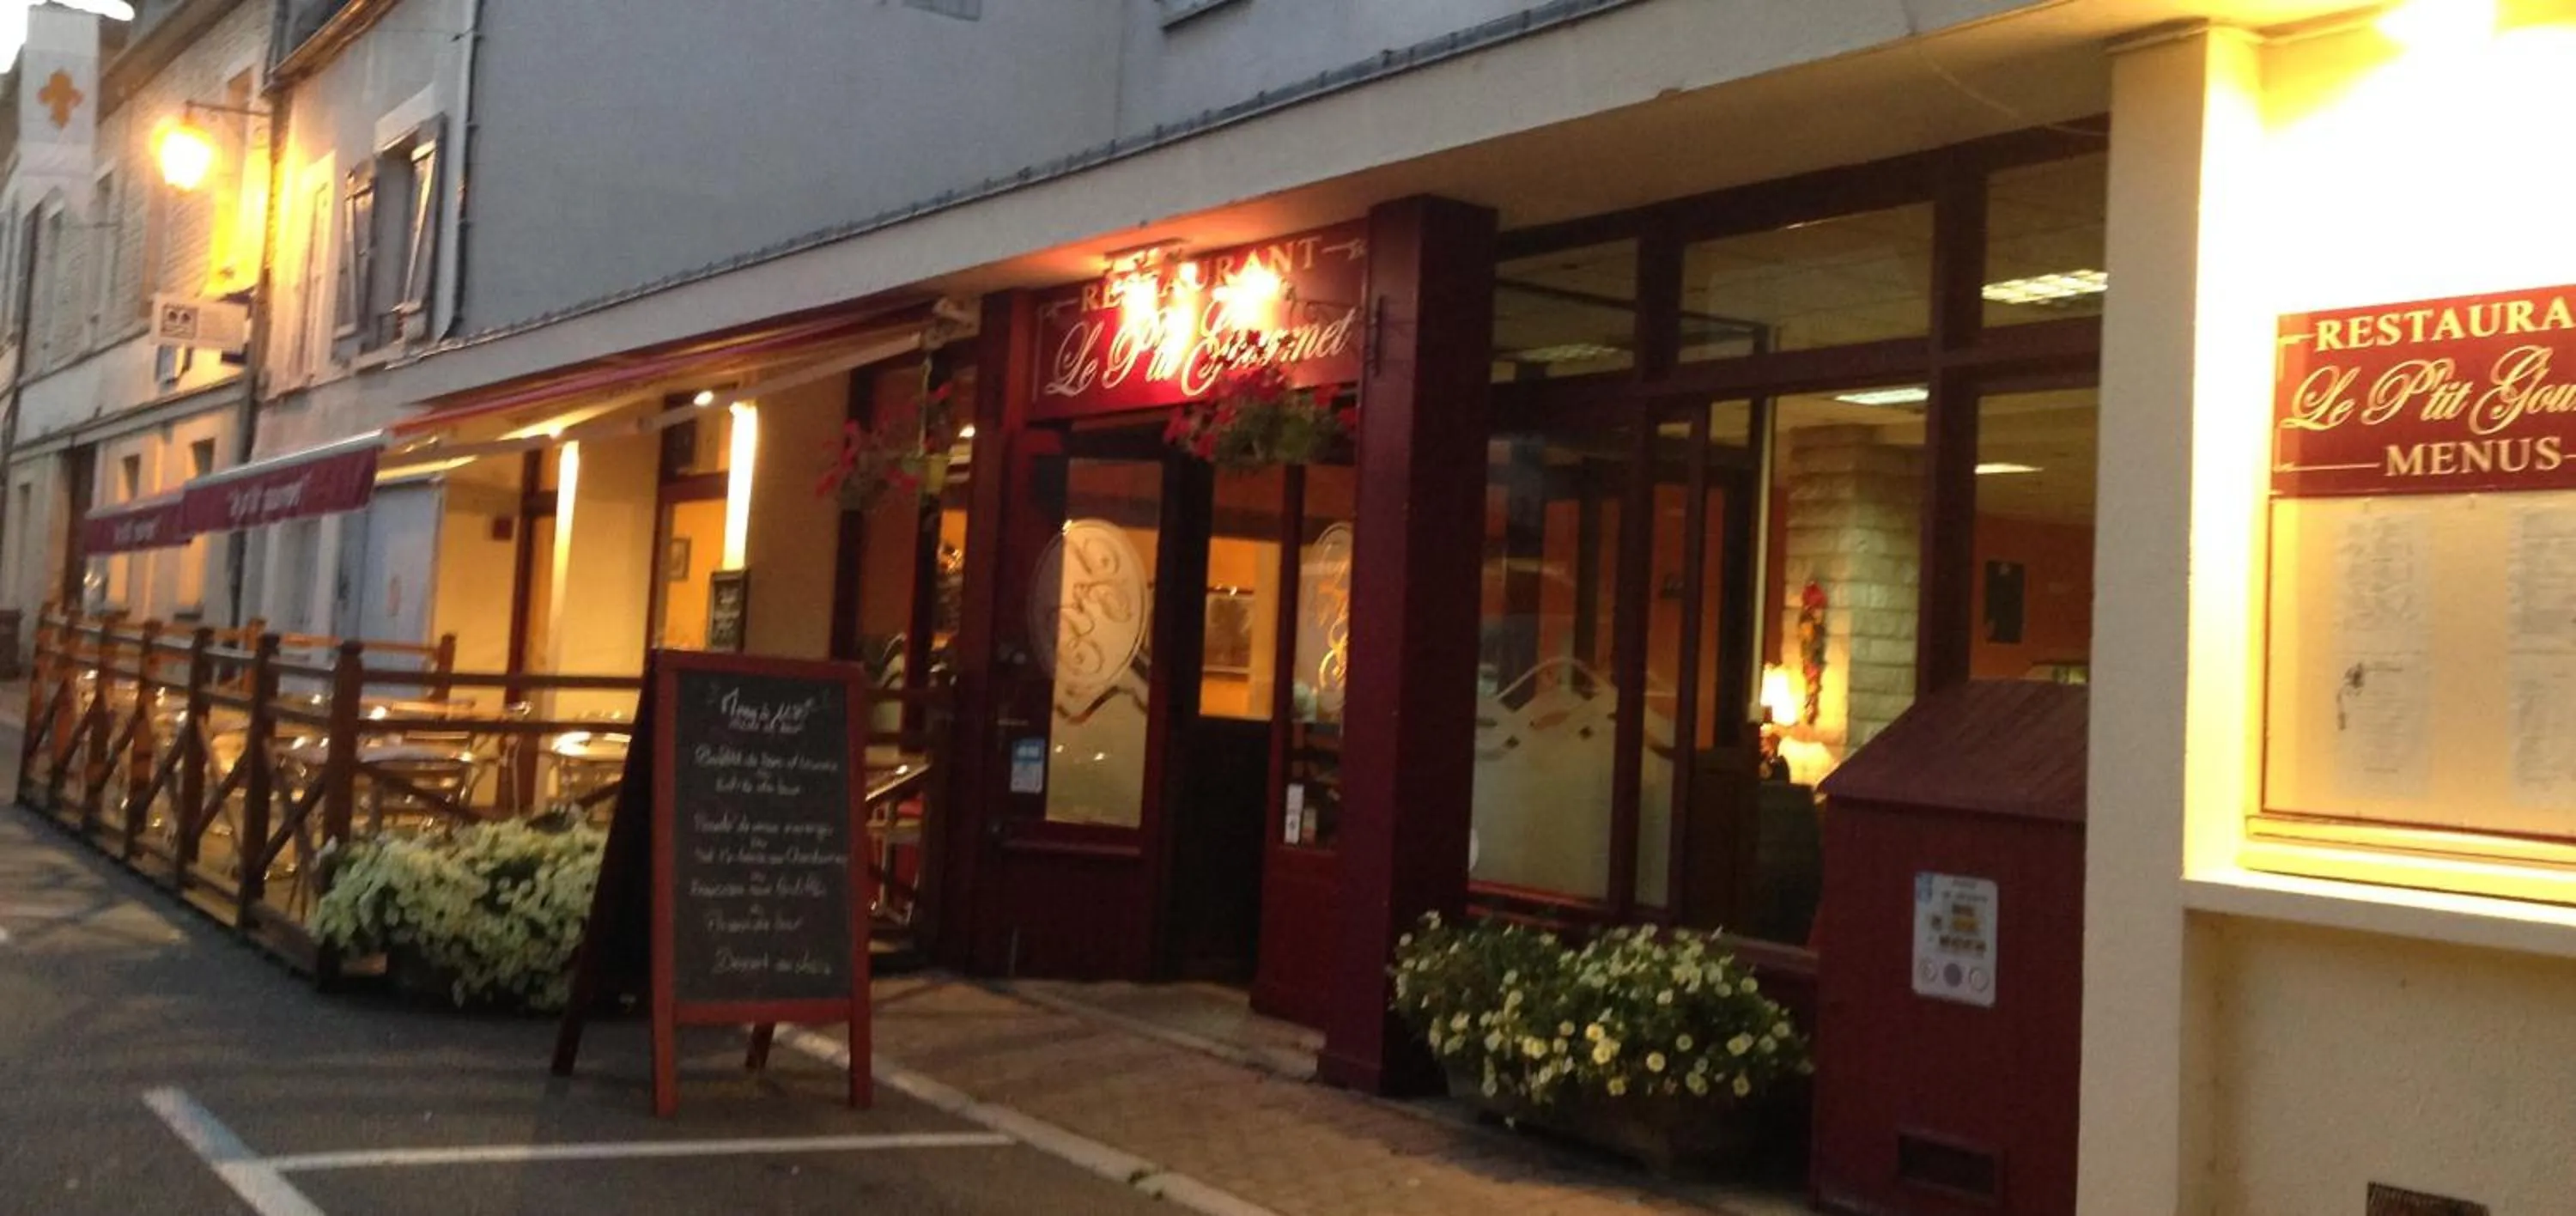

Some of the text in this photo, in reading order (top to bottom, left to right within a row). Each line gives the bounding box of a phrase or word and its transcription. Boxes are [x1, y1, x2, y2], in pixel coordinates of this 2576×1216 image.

[1080, 236, 1322, 312] REURANT
[1043, 320, 1105, 397] Le
[2314, 296, 2576, 352] RESTAURA
[2280, 365, 2361, 431] Le
[2360, 357, 2474, 426] P'tit
[2384, 436, 2562, 477] MENUS
